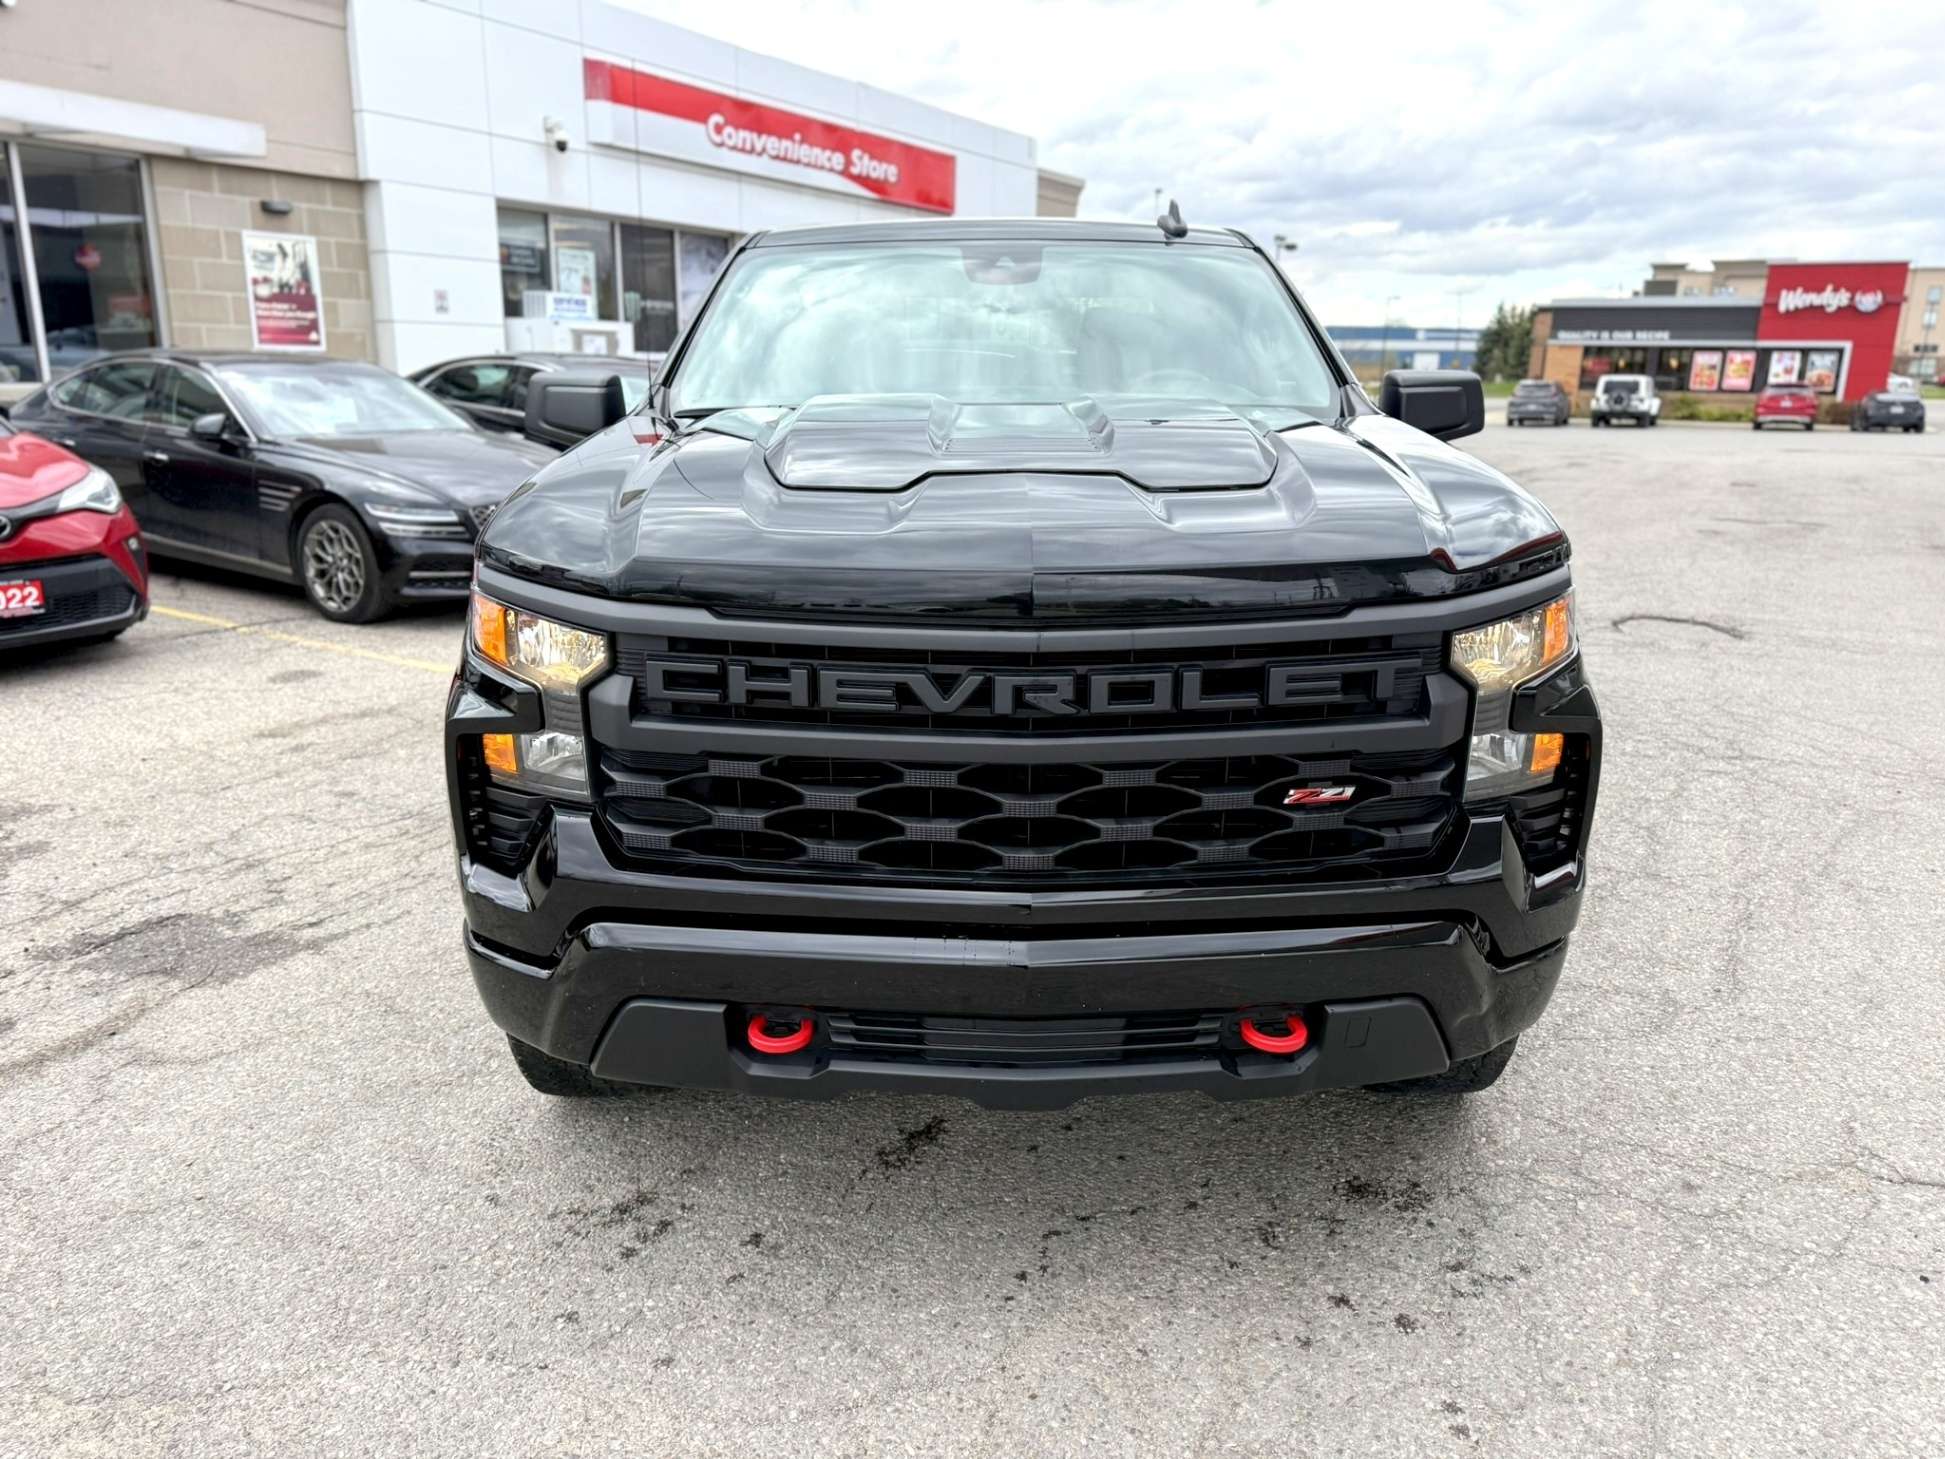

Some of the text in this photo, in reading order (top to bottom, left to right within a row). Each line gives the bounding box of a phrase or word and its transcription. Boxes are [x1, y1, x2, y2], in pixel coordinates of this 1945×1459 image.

[707, 113, 899, 184] Convenience Store
[1778, 284, 1852, 314] Wendy's
[645, 657, 1423, 715] CHEVROLET
